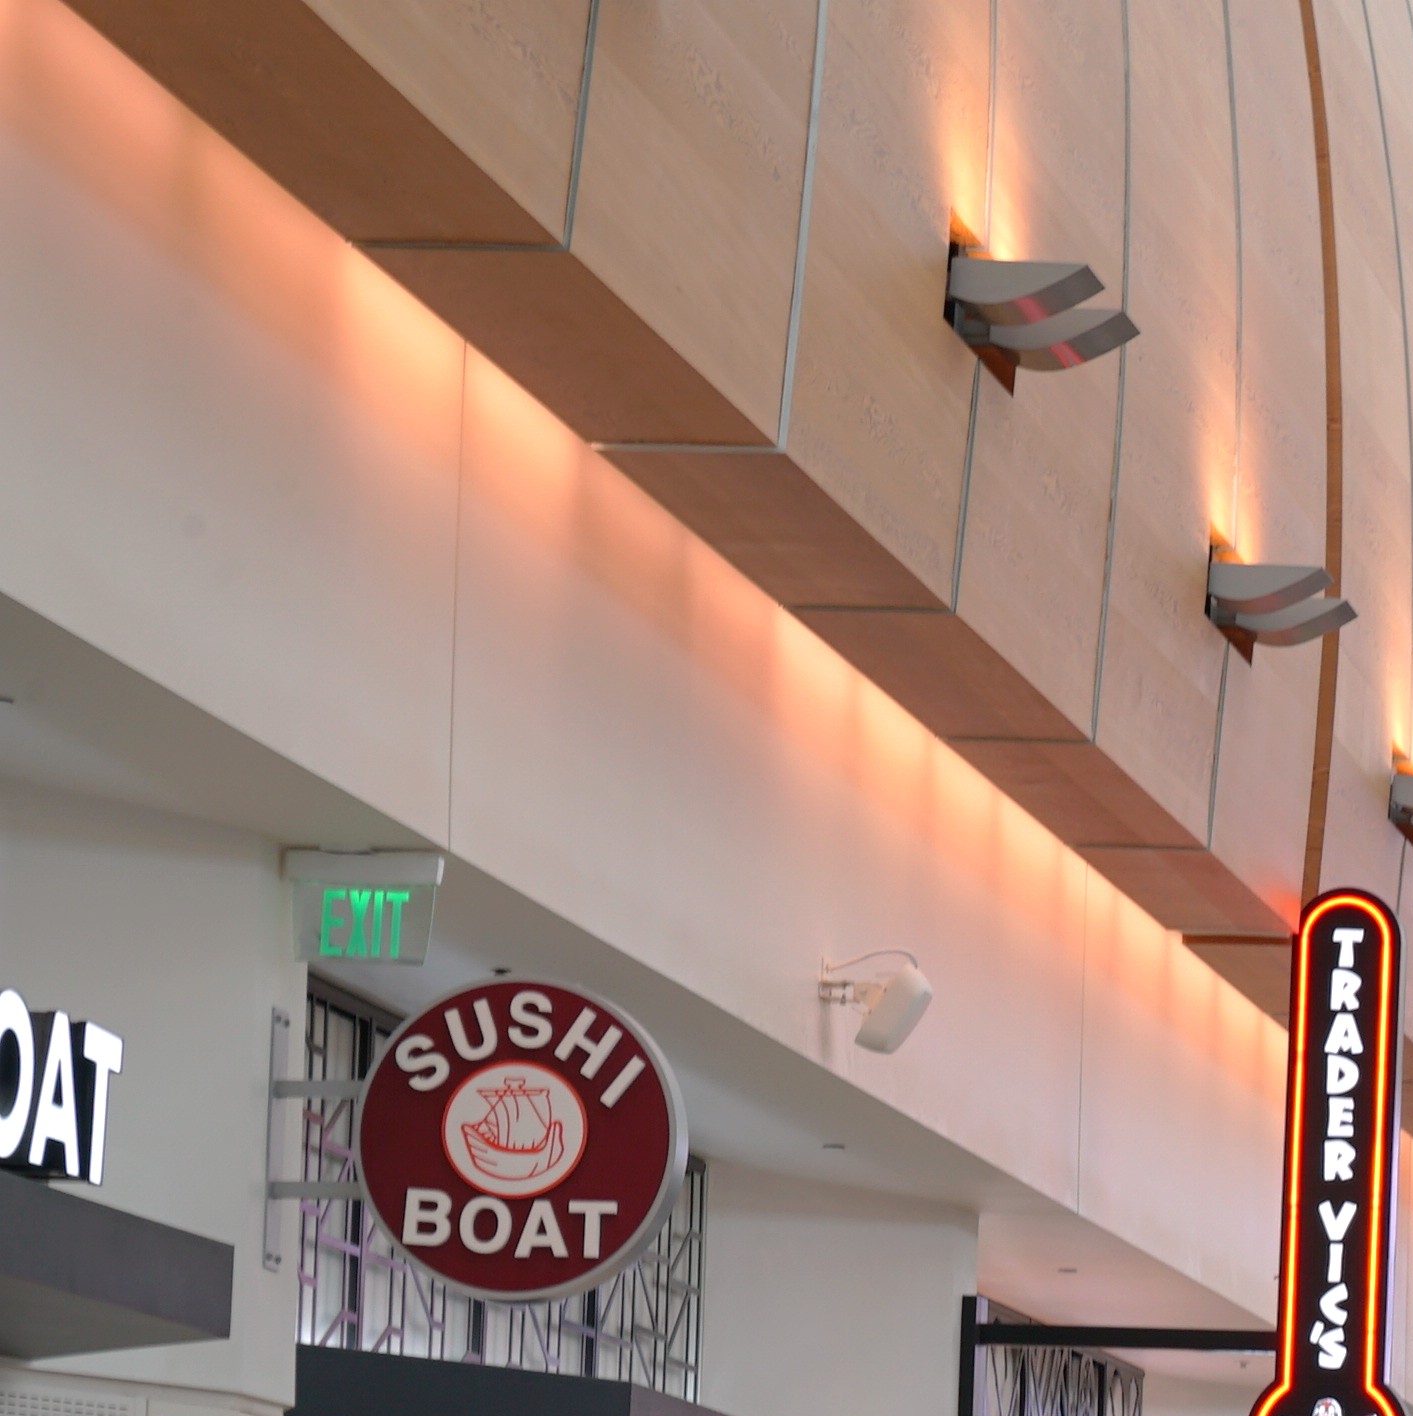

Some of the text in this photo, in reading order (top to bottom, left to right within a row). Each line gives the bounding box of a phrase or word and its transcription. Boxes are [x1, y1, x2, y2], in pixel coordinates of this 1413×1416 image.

[320, 889, 410, 957] EXIT
[394, 991, 646, 1109] SUSHI
[1310, 927, 1365, 1370] TRADER VIC'S
[400, 1187, 618, 1260] BOAT
